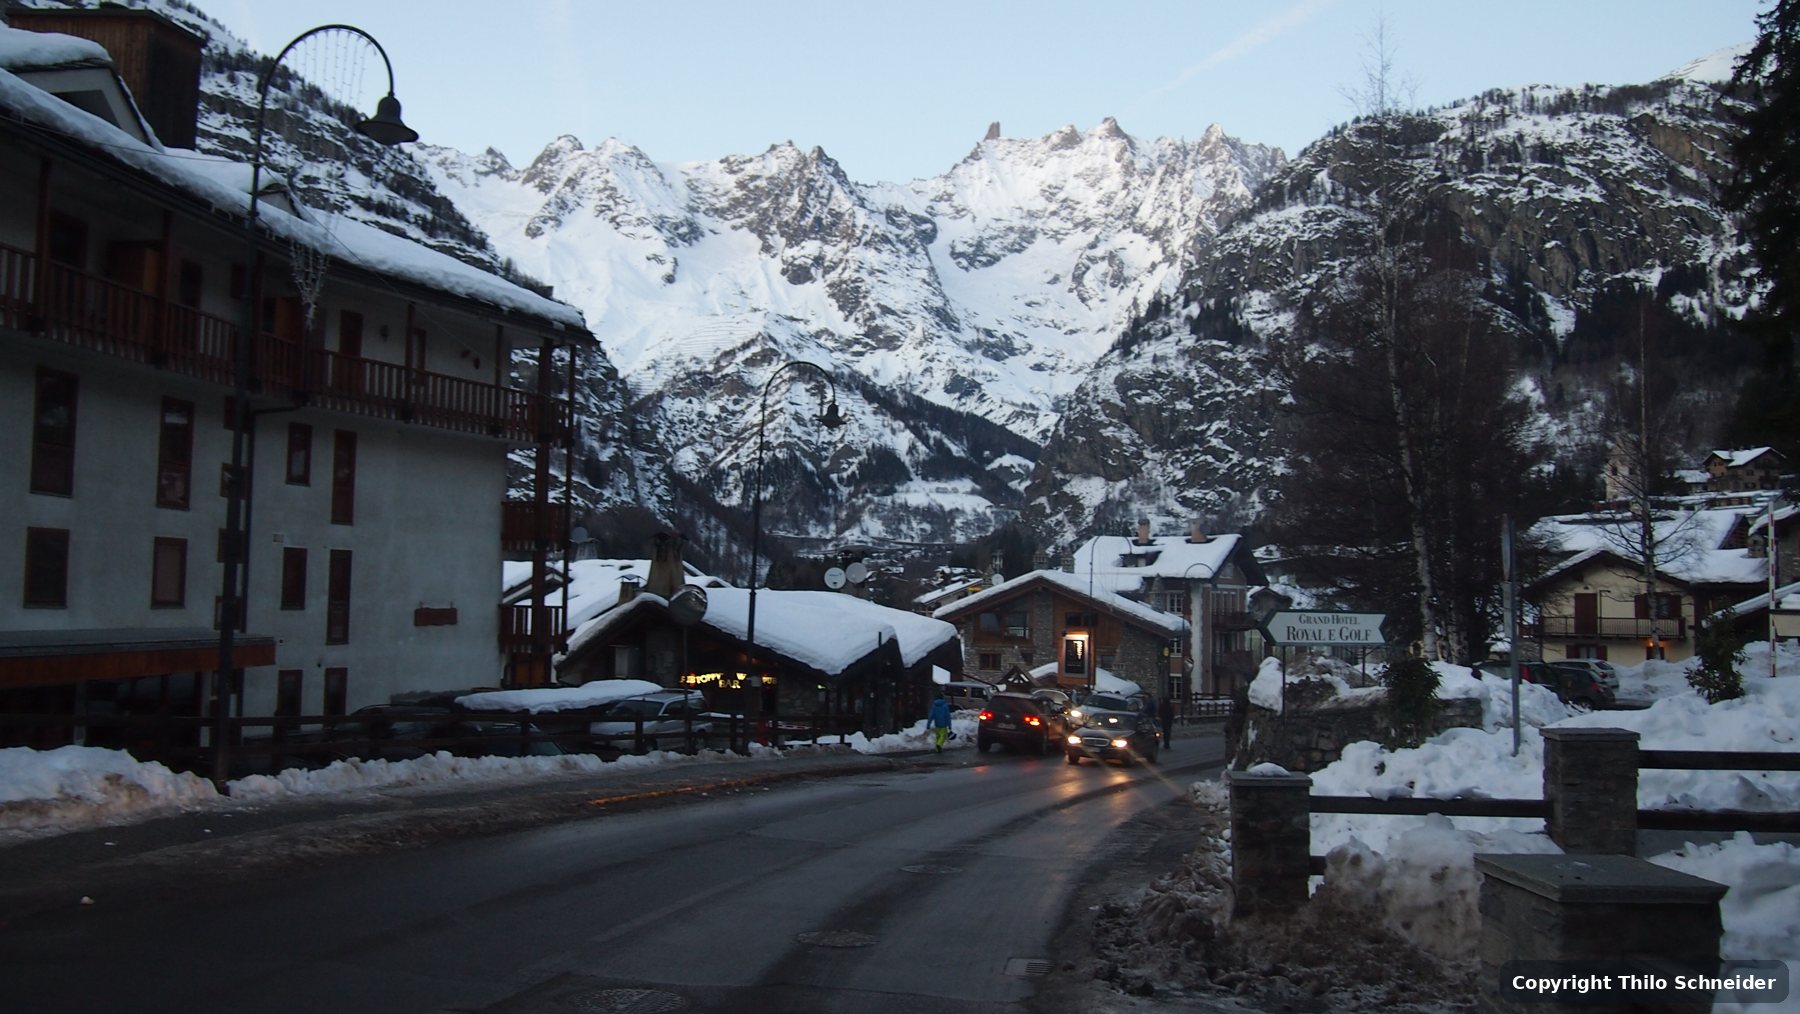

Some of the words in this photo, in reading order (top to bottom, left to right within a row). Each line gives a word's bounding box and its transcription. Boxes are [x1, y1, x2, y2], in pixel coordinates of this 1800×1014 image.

[1298, 613, 1330, 625] GRAND
[1331, 614, 1360, 625] HOTEL
[1286, 626, 1325, 641] ROYAL
[1328, 628, 1336, 641] E
[1339, 626, 1372, 642] GOLF
[718, 679, 741, 689] BAR
